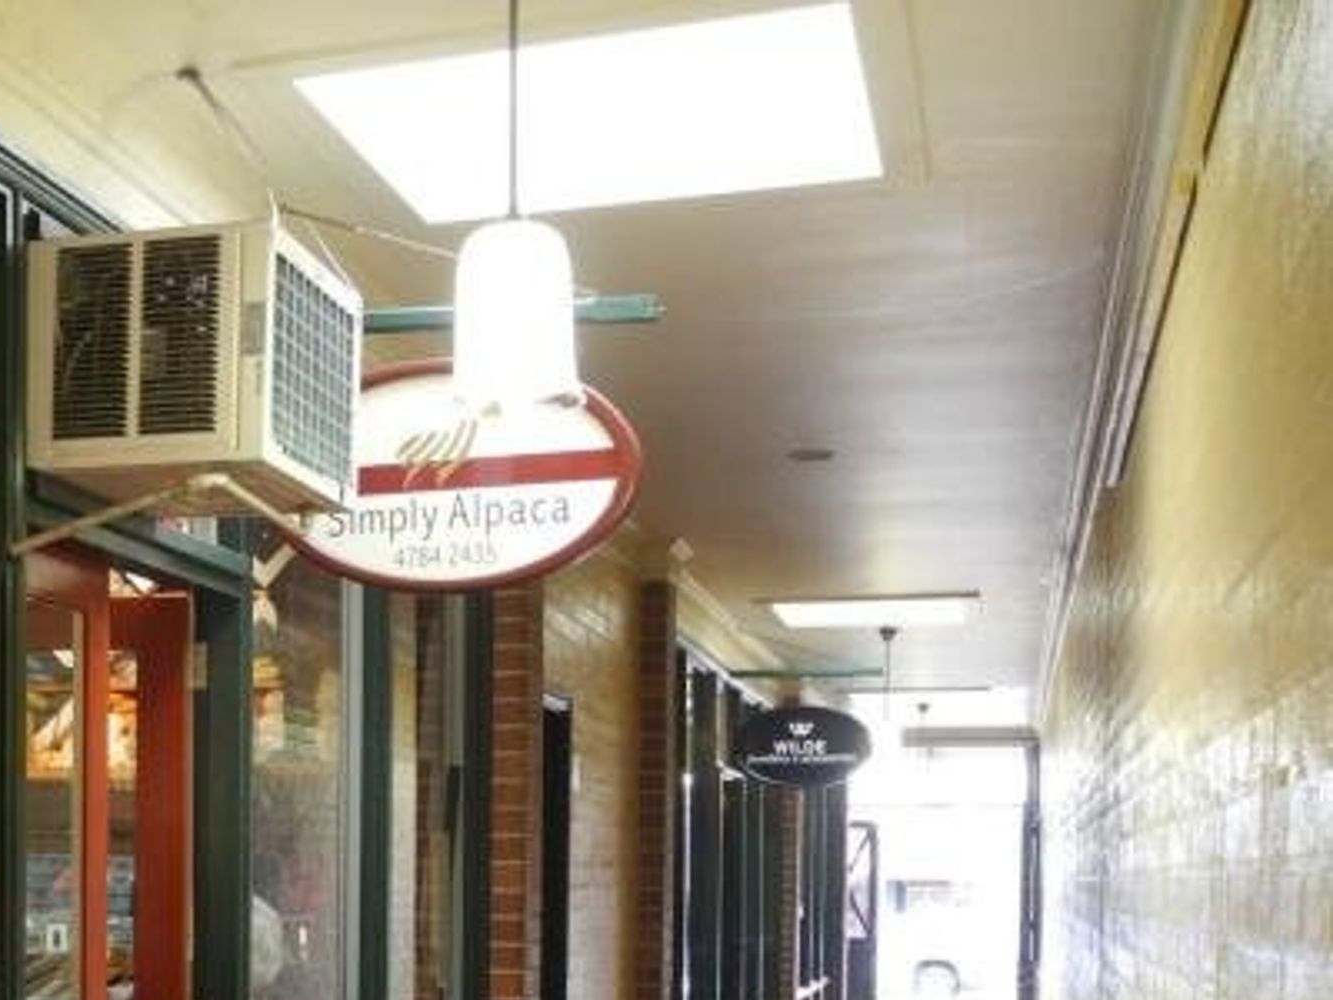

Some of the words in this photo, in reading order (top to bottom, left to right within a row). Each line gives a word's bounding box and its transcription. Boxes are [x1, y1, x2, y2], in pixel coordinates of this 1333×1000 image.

[328, 499, 438, 542] Simply
[448, 491, 570, 534] Alpaca
[773, 739, 827, 754] WILDE
